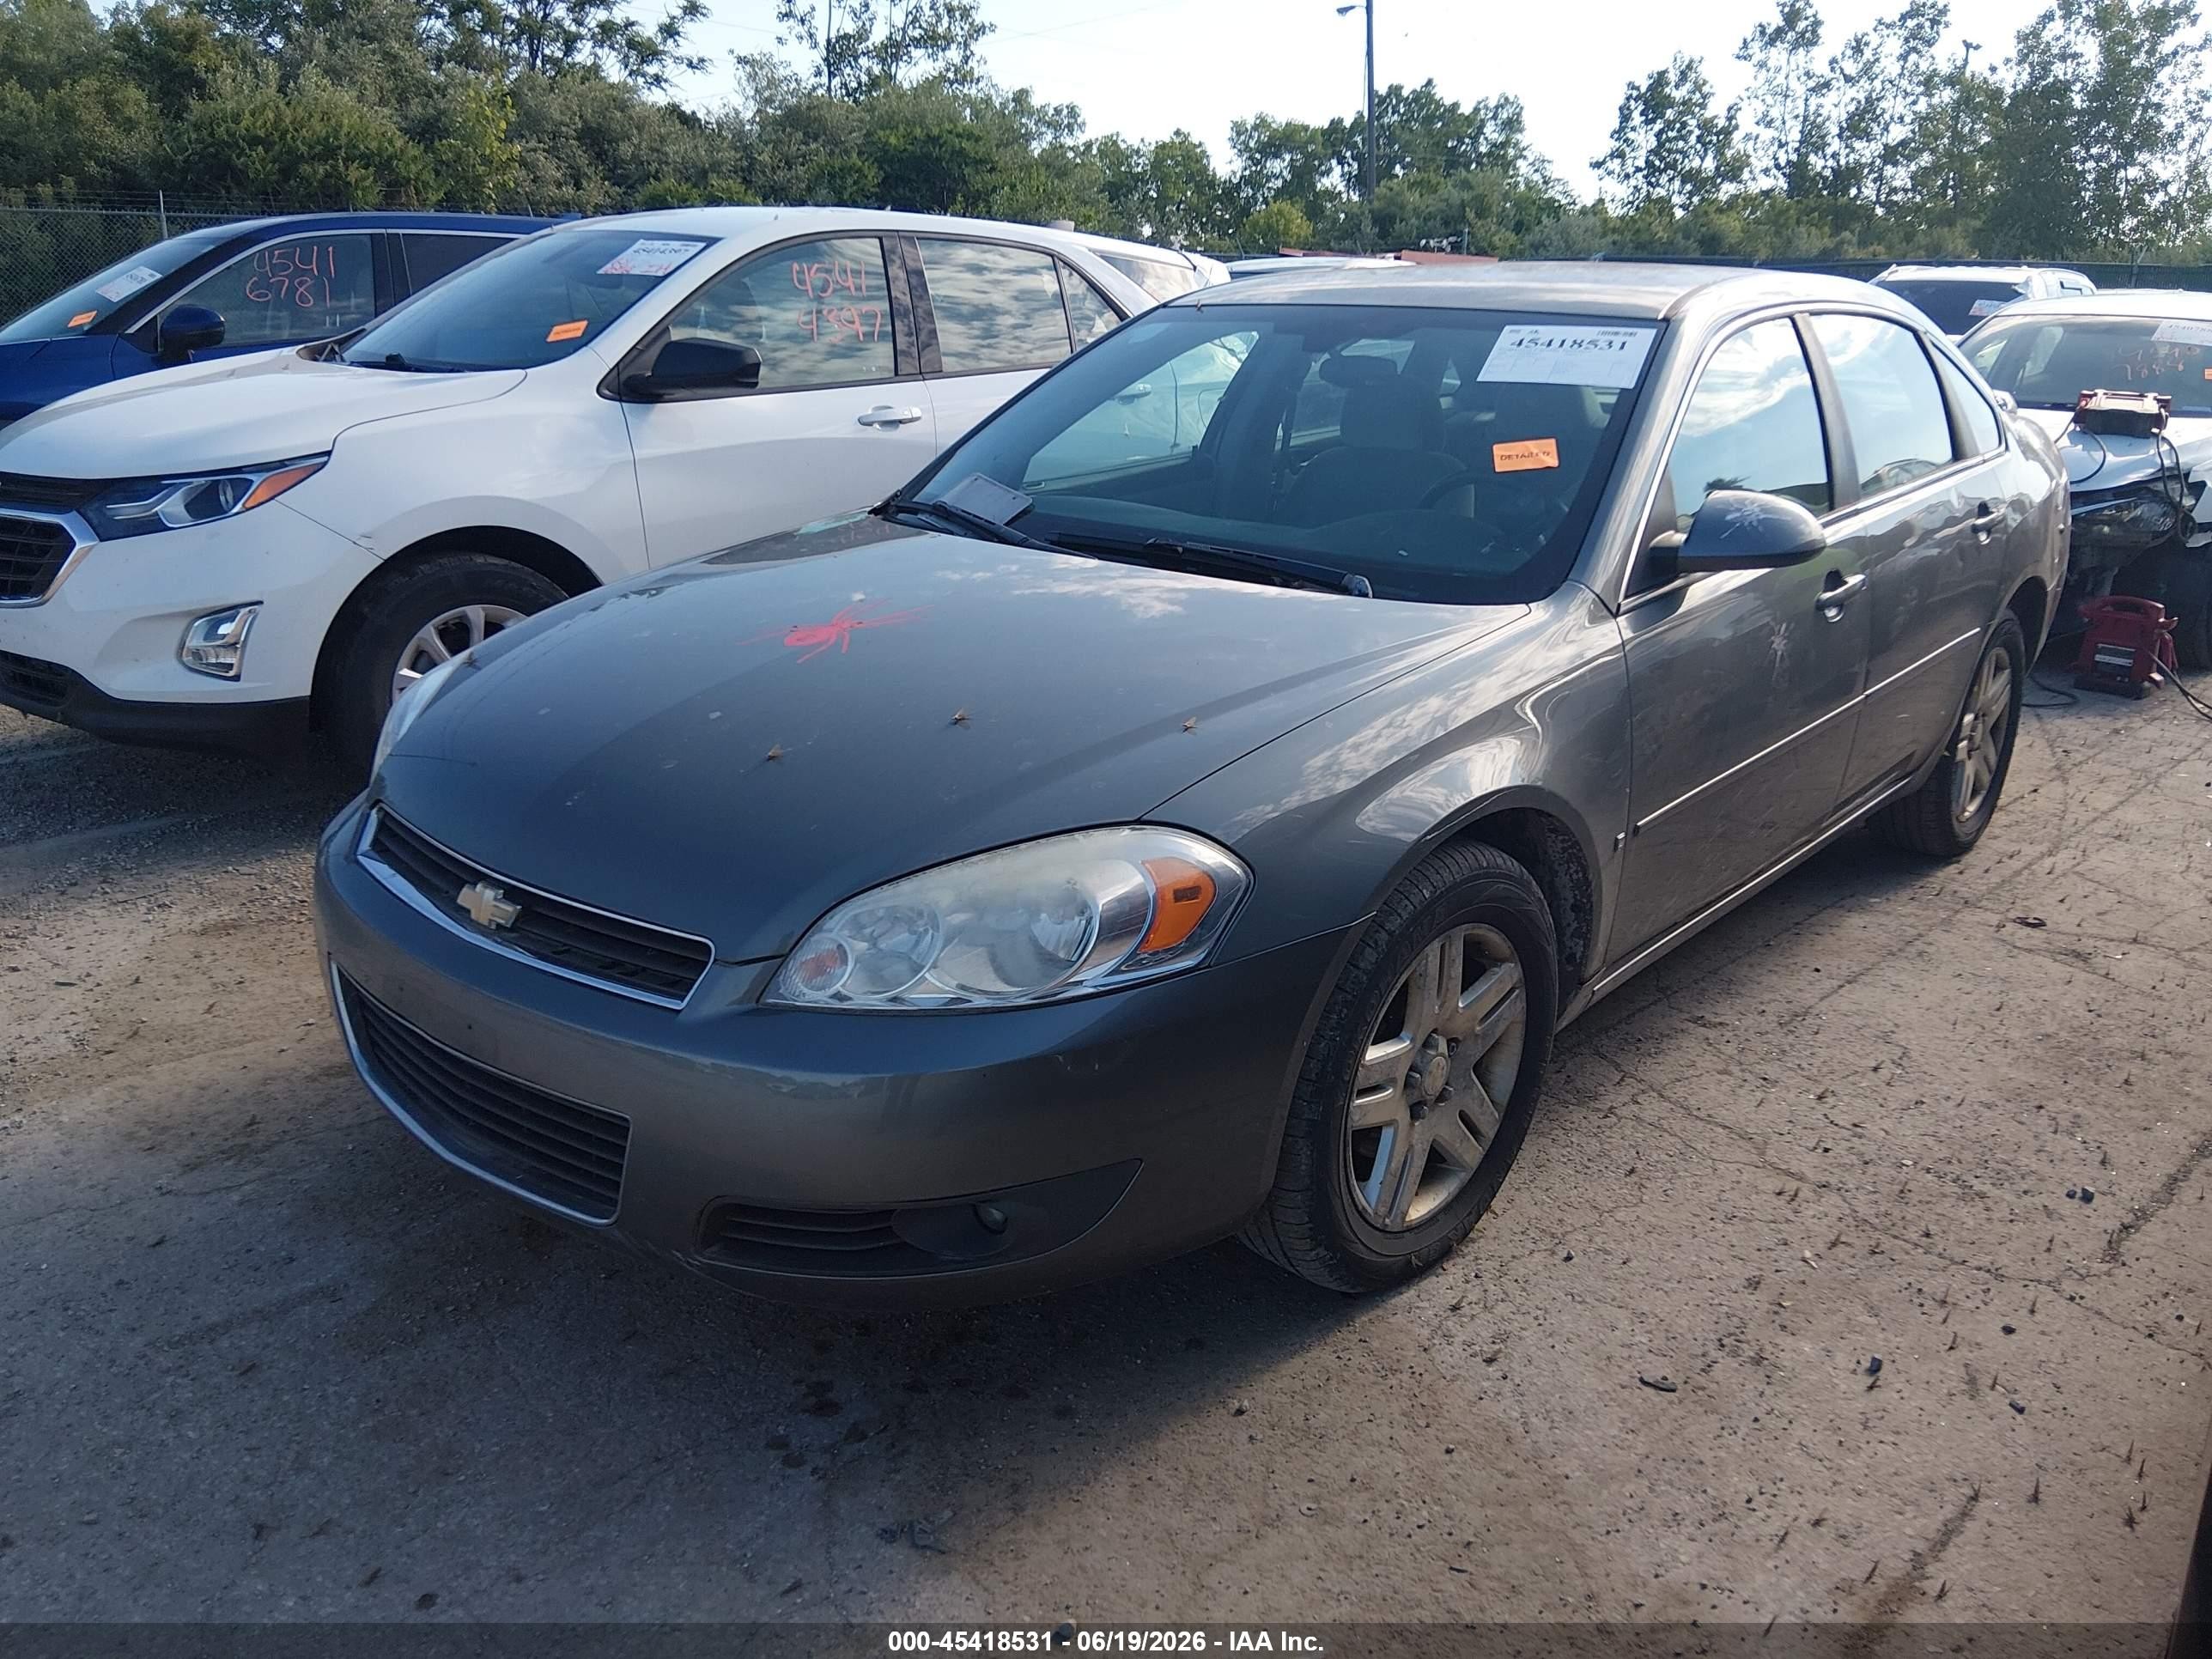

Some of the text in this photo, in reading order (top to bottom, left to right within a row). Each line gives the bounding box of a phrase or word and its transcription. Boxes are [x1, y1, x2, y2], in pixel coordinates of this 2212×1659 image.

[253, 246, 335, 278] 4541
[246, 276, 331, 308] 6781
[792, 260, 866, 299] 4541
[1510, 337, 1628, 351] 45418531
